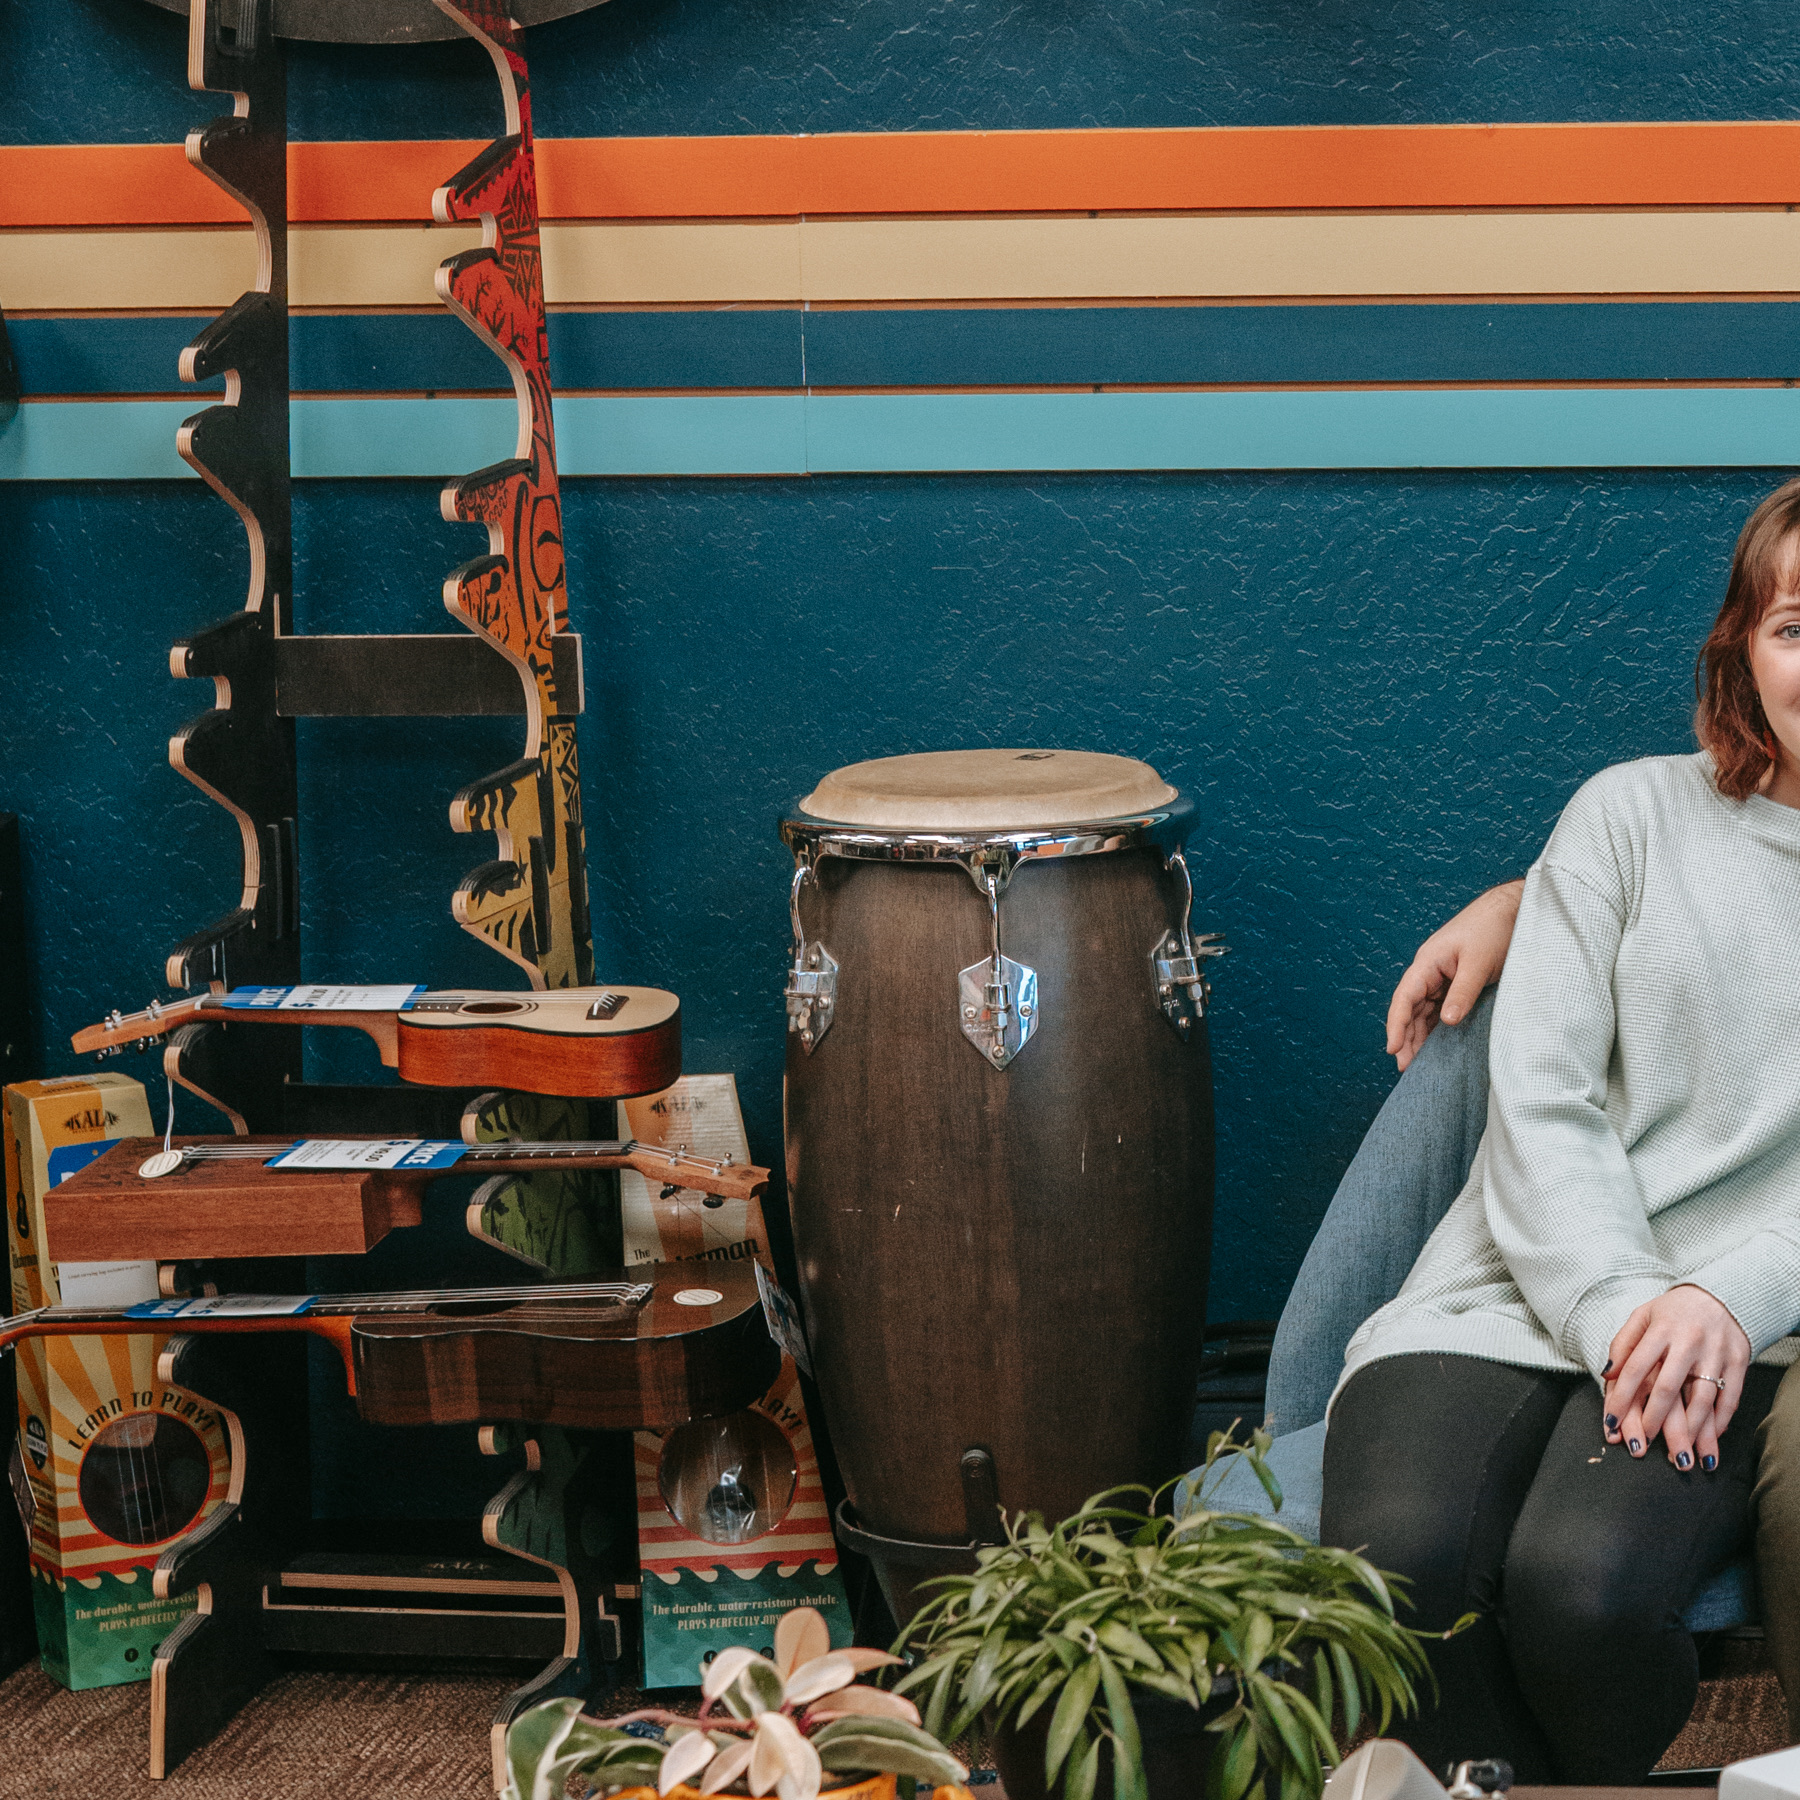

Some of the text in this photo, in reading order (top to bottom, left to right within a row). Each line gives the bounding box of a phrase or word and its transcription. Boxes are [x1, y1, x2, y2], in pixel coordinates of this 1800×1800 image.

[68, 1108, 115, 1130] KALA
[634, 1248, 651, 1261] The
[68, 1397, 124, 1451] LEARN
[130, 1390, 154, 1408] TO
[160, 1391, 216, 1433] PLAY!
[652, 1604, 670, 1615] The
[718, 1597, 797, 1612] water-resistant
[799, 1594, 839, 1606] ukulele.
[75, 1609, 92, 1621] The
[677, 1618, 707, 1631] PLAYS
[709, 1616, 760, 1629] PERFECTLY
